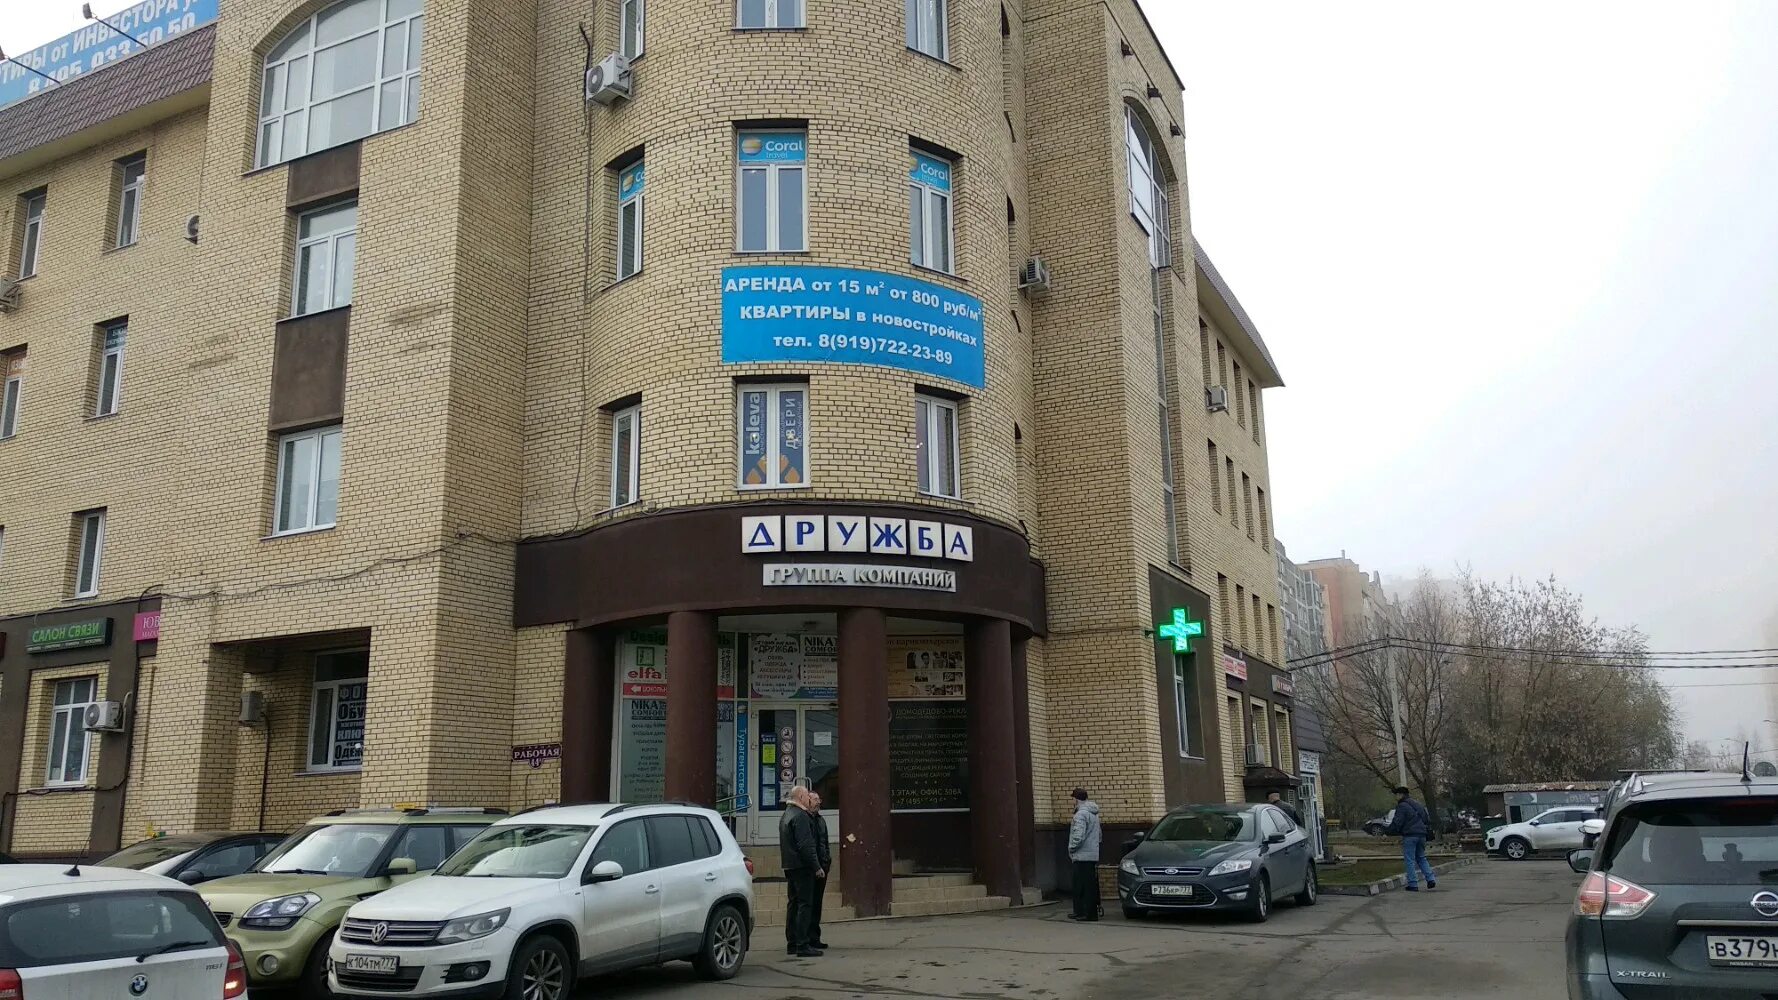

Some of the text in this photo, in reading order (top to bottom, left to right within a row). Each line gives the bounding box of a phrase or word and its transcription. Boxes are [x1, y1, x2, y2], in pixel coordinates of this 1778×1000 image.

[51, 42, 69, 63] от
[765, 140, 803, 152] Coral
[921, 163, 948, 181] Coral
[724, 277, 805, 293] АРЕНДА
[811, 280, 832, 292] от
[838, 280, 860, 294] 15
[890, 288, 907, 301] от
[911, 291, 940, 308] 800
[740, 306, 977, 347] КВАРТИРЫ в новостройках
[773, 334, 953, 365] тел. 8(919)722-23-89
[745, 393, 760, 455] kaleva
[785, 398, 799, 450] ДВЕРИ
[748, 521, 968, 555] ДРУЖБА
[770, 567, 955, 589] ГРУППА КОМПАНИЙ
[32, 621, 100, 643] САЛОН СВЯЗИ
[804, 636, 834, 646] NIKA
[627, 666, 662, 680] elfa
[631, 700, 659, 710] NIKA
[514, 747, 560, 759] РАБОЧАЯ
